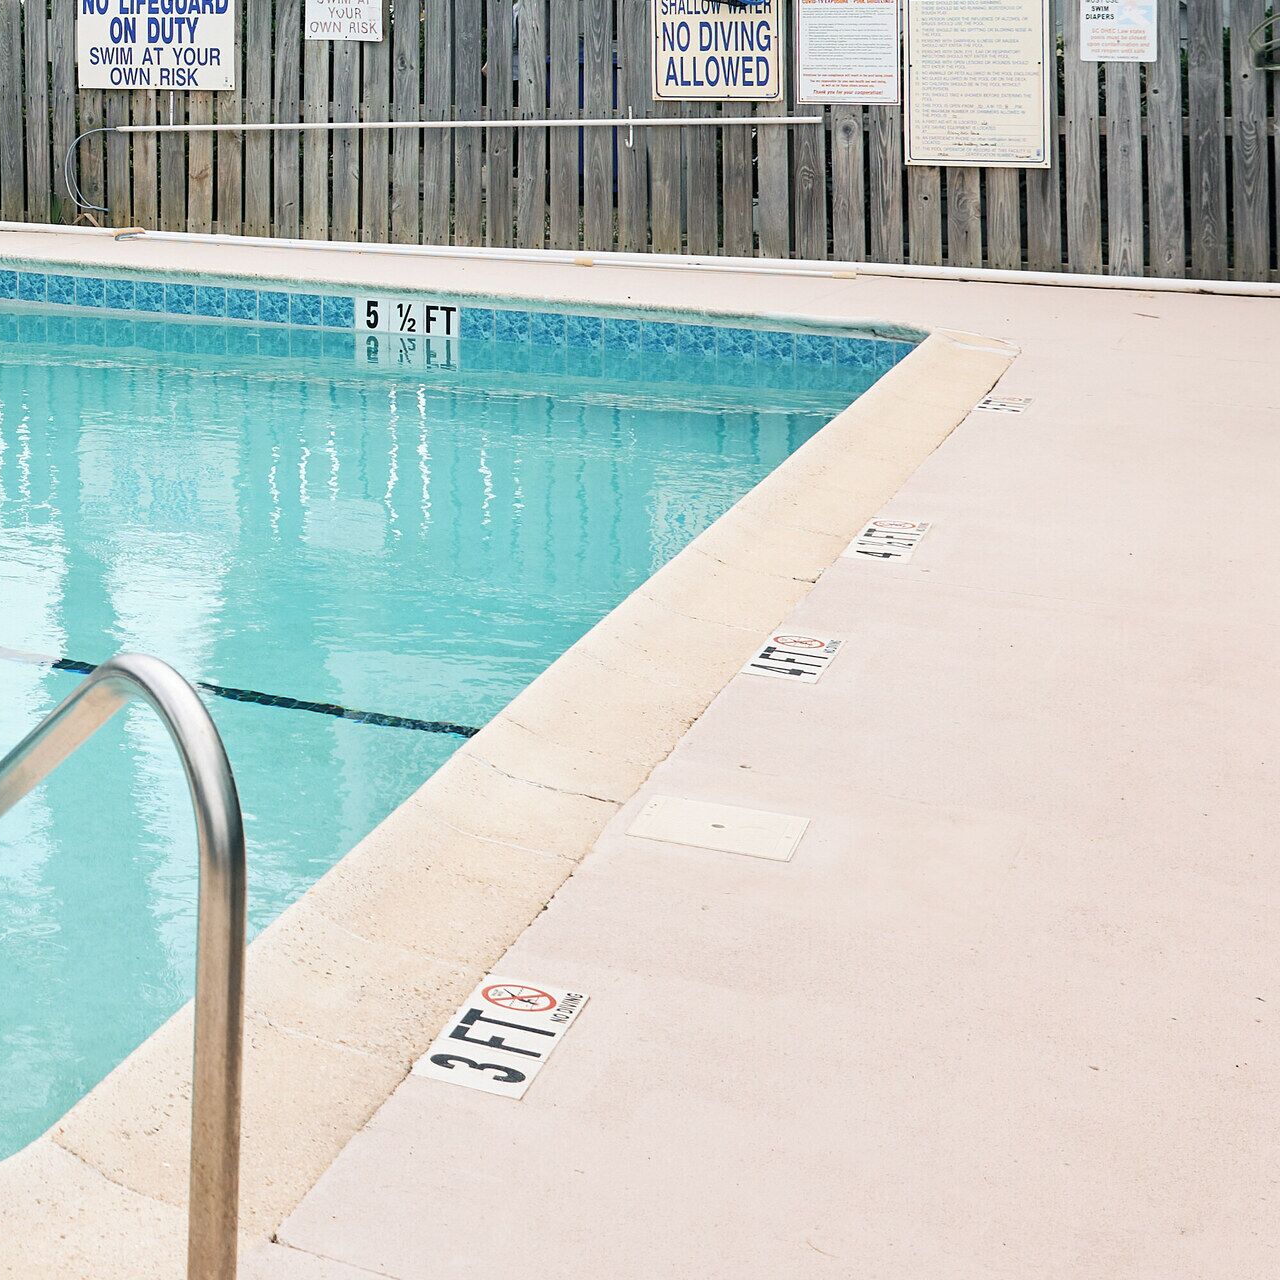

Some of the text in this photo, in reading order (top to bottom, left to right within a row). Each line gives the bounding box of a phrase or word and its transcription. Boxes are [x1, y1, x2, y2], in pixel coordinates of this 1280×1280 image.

[310, 21, 378, 34] OWN RISK
[328, 7, 361, 19] YOUR
[110, 17, 199, 44] ON DUTY
[662, 21, 690, 52] NO
[699, 20, 771, 52] DIVING
[90, 47, 220, 65] SWIM AT YOUR
[110, 67, 198, 86] OWN RISK
[665, 56, 769, 87] ALLOWED
[366, 300, 379, 329] 5
[426, 305, 457, 335] FT
[864, 528, 920, 541] FT
[751, 646, 828, 677] 4 FT
[550, 992, 583, 1024] NO DIVING
[430, 1008, 556, 1083] 3 FT
